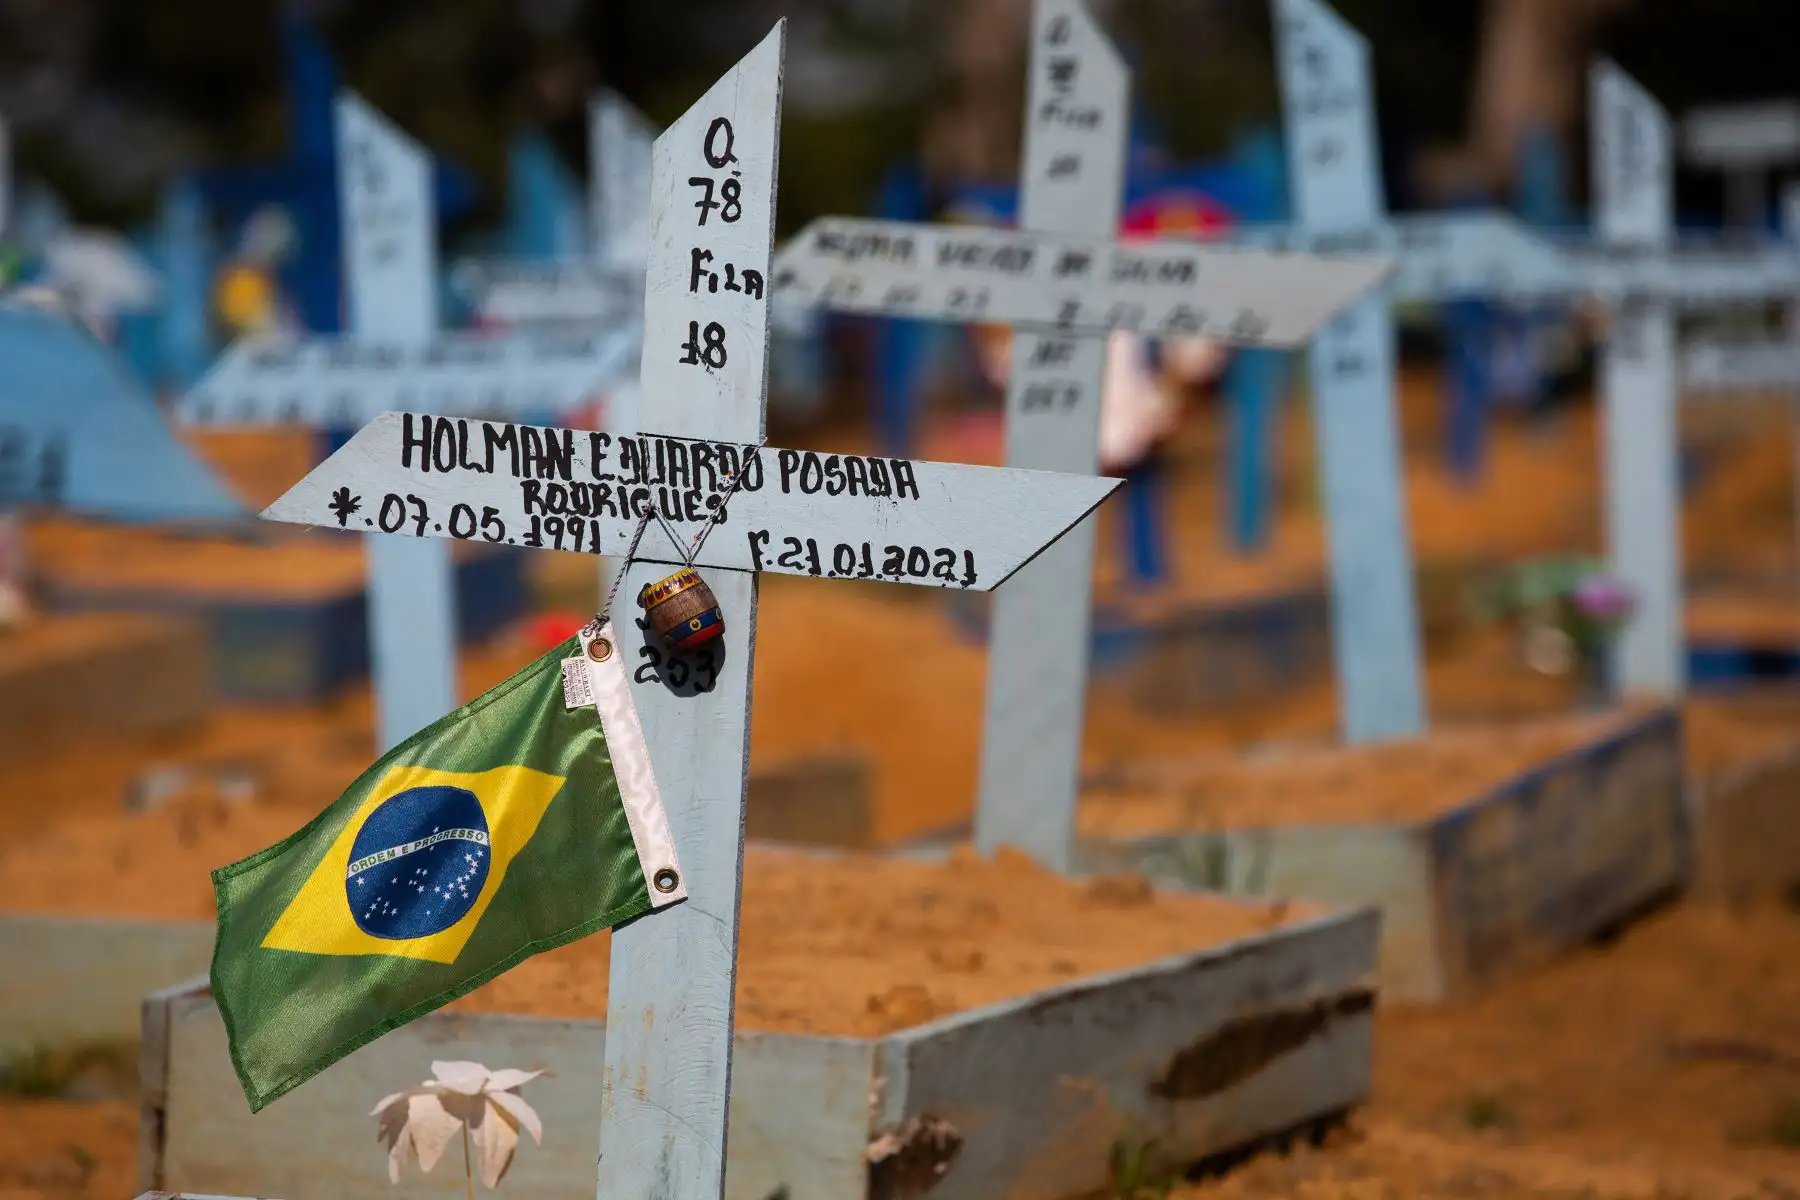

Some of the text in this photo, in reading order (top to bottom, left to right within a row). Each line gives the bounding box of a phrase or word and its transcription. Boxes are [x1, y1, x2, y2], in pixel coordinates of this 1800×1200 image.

[689, 177, 741, 226] 78
[680, 321, 727, 369] 18
[402, 413, 920, 500] HOLMAN EDUARDO POSADA
[351, 830, 484, 873] ORDEM E PROGRESSO
